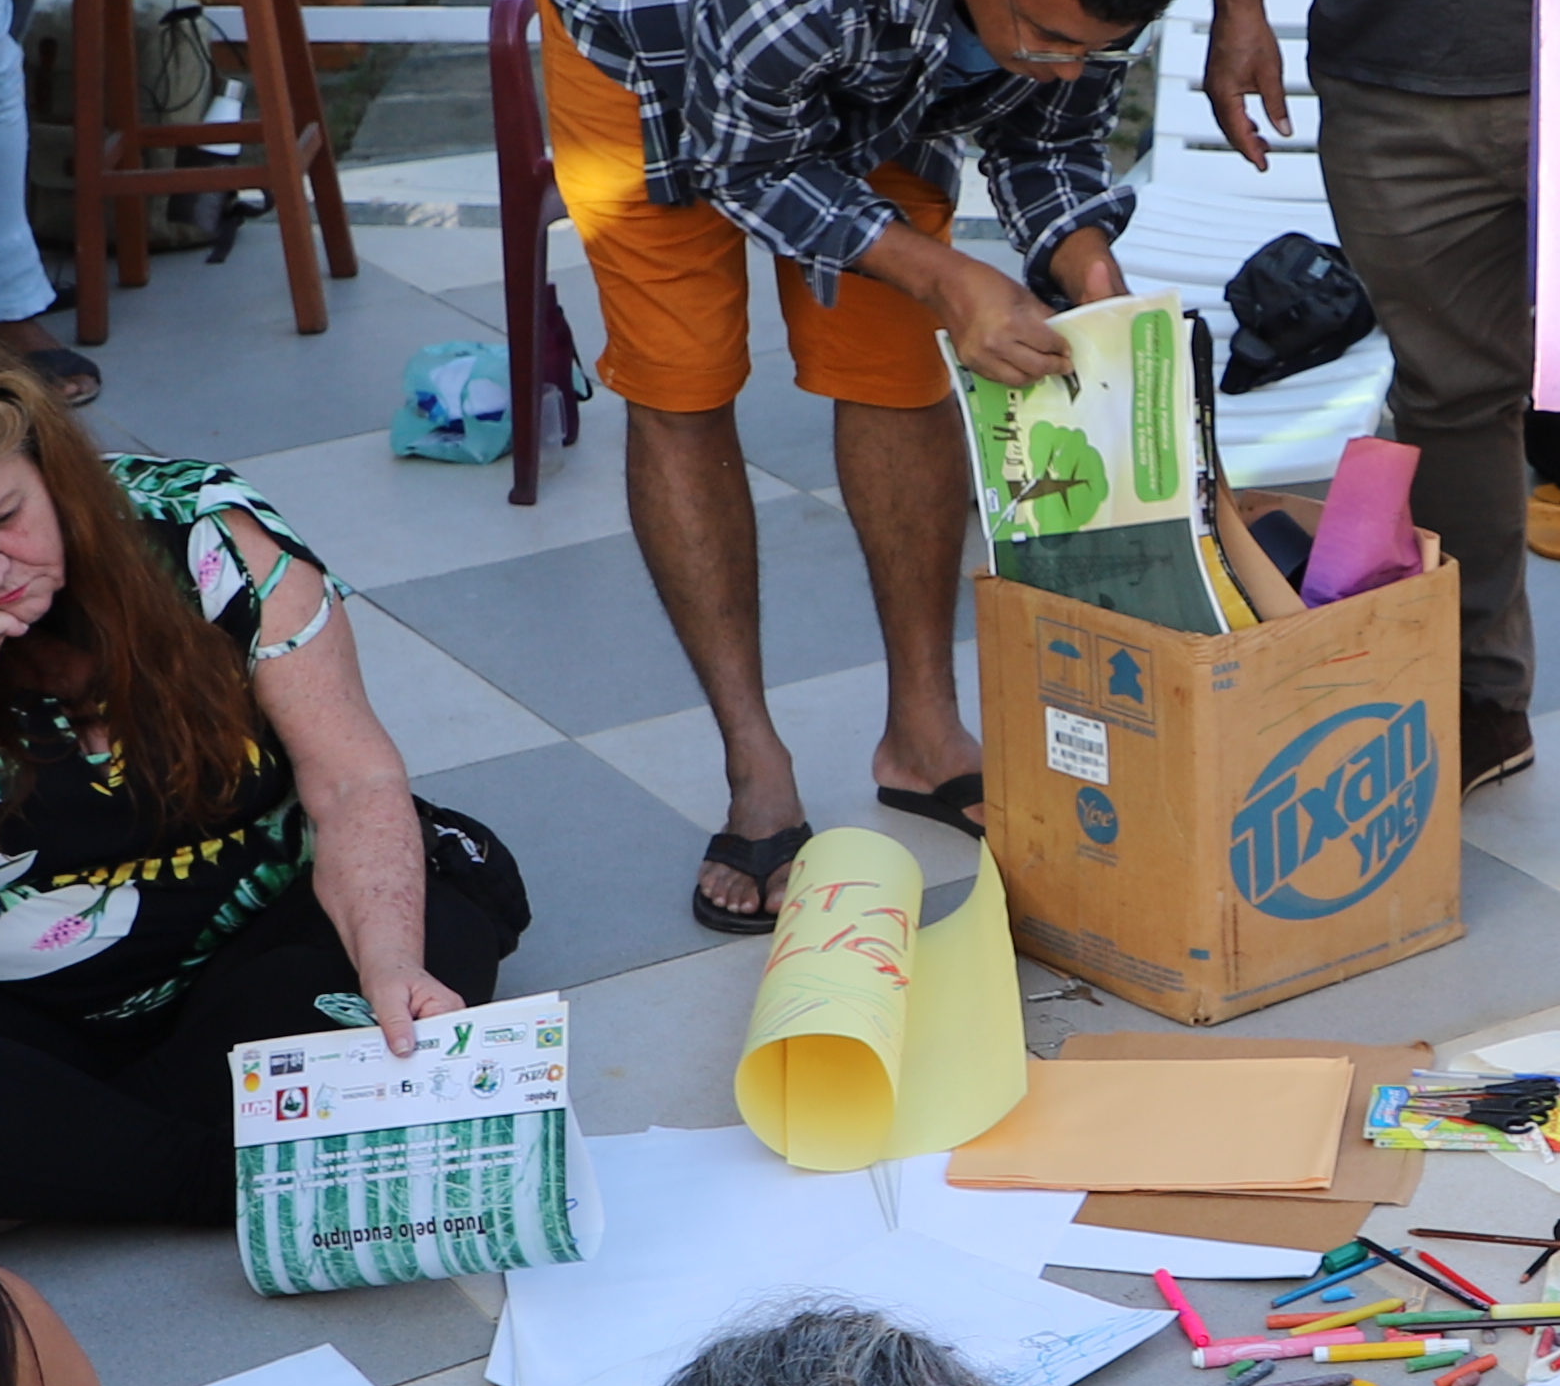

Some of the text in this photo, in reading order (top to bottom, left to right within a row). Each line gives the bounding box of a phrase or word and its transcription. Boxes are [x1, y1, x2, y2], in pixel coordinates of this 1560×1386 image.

[1231, 700, 1428, 904] Tixan
[312, 1215, 487, 1252] Tudo pelo eucalipto
